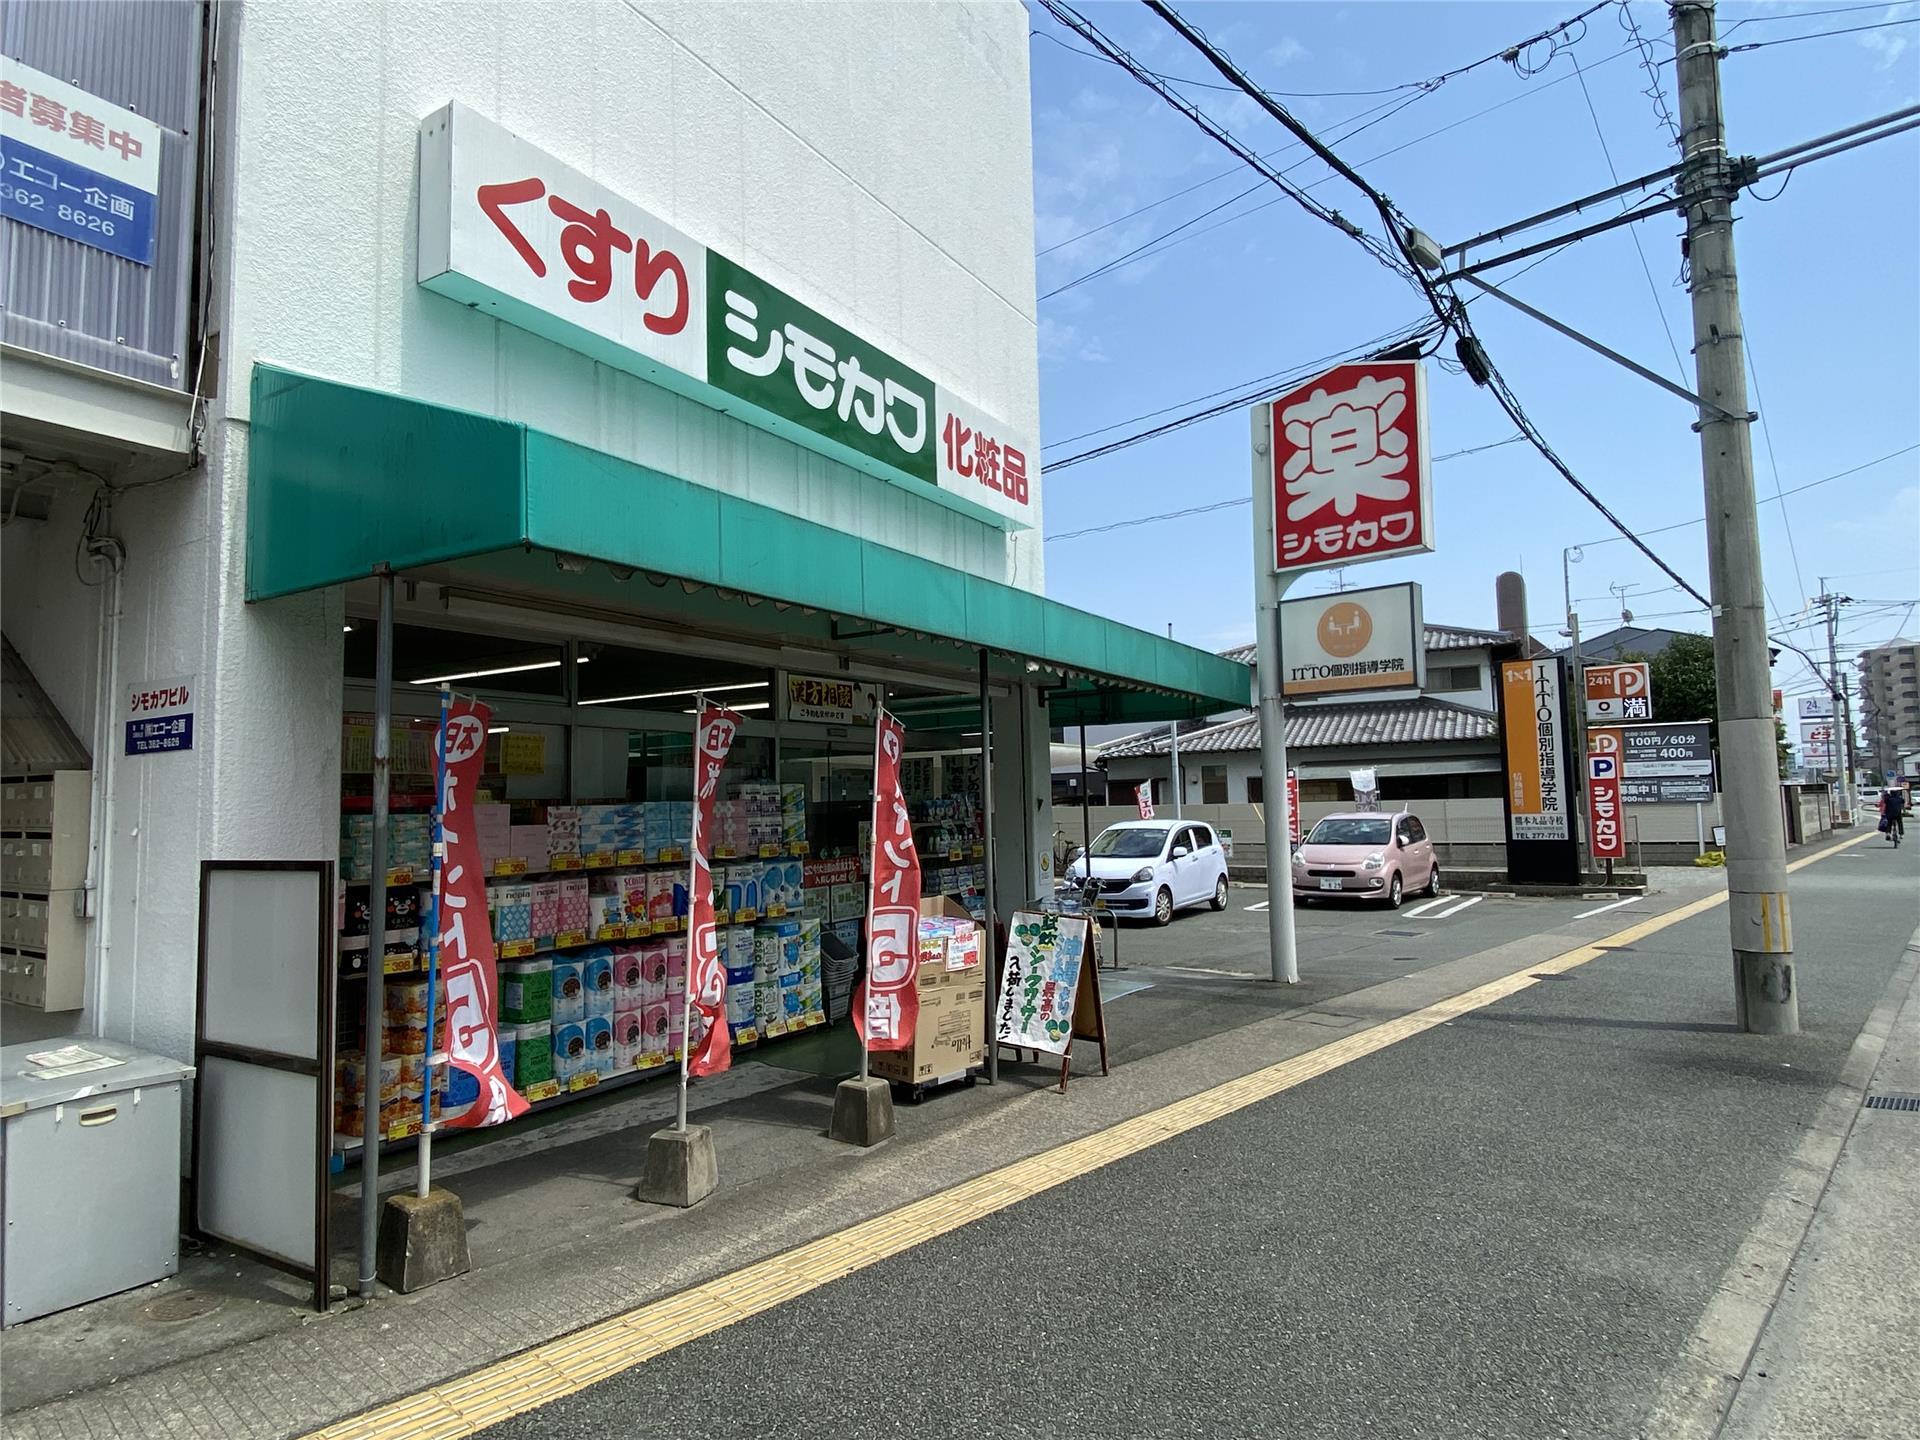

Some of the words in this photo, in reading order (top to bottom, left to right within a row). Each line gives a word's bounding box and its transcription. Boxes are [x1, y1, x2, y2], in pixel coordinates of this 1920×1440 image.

[58, 204, 115, 237] 8626
[477, 177, 690, 336] くすり
[724, 289, 927, 454] シモカワ
[942, 412, 1030, 506] 化粧品
[1282, 510, 1414, 560] シモカワ
[1291, 658, 1405, 681] ITTO個別指導学院
[1588, 676, 1612, 686] 24h
[131, 685, 190, 712] シモカワビル
[1623, 697, 1647, 718] 満
[1535, 665, 1559, 811] ITTO個別指導学院
[1660, 747, 1693, 758] 400円
[1594, 759, 1613, 778] P
[1593, 786, 1618, 851] シモカワ
[1020, 945, 1046, 1034] シークワーサー
[1039, 980, 1057, 1021] 最高の
